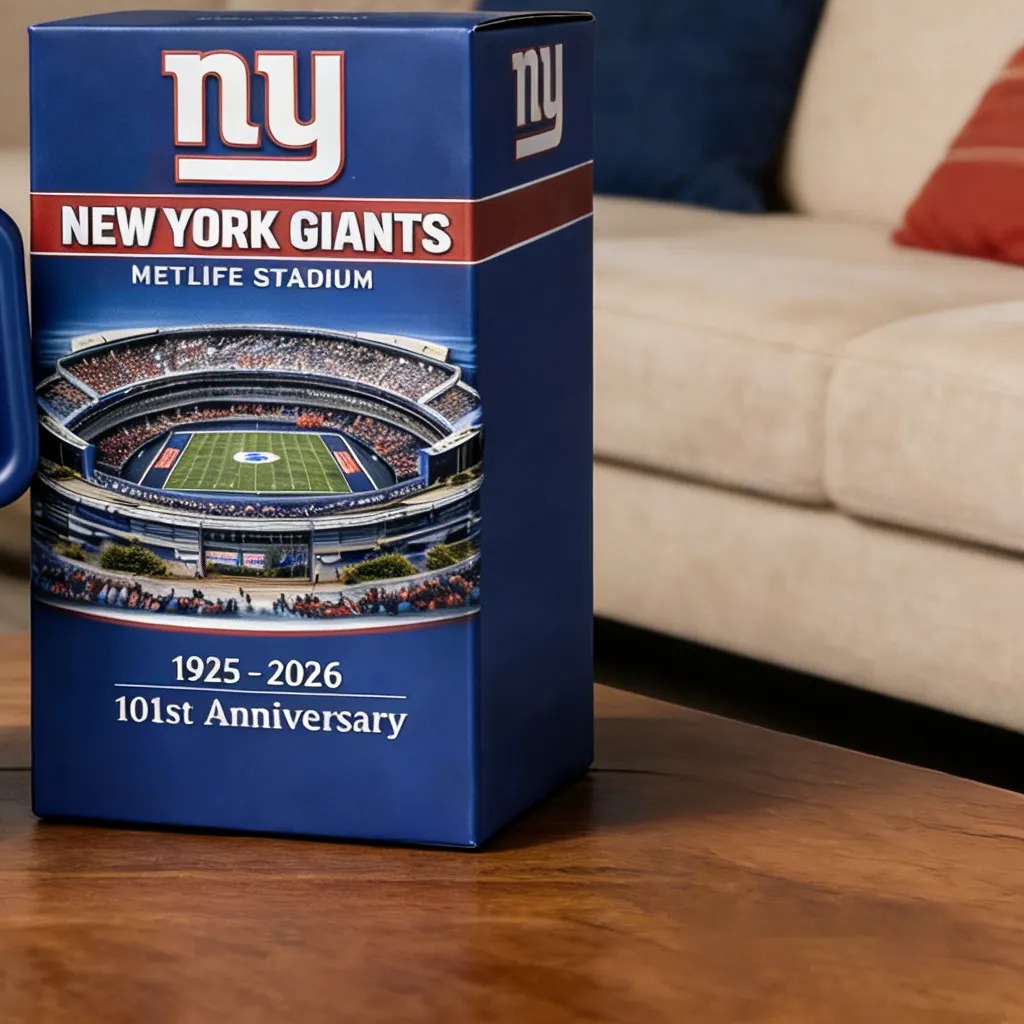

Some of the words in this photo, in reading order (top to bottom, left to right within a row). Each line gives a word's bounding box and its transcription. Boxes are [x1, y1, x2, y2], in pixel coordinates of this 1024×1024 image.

[161, 50, 345, 185] ny
[512, 43, 563, 160] ny
[62, 206, 156, 247] NEW
[164, 208, 279, 250] YORK
[290, 211, 452, 253] GIANTS
[131, 264, 244, 287] METLIFE
[253, 267, 373, 290] STADIUM
[172, 655, 240, 683] 1925
[268, 660, 343, 689] 2026
[115, 696, 194, 725] 101st
[204, 698, 408, 739] Anniversary
